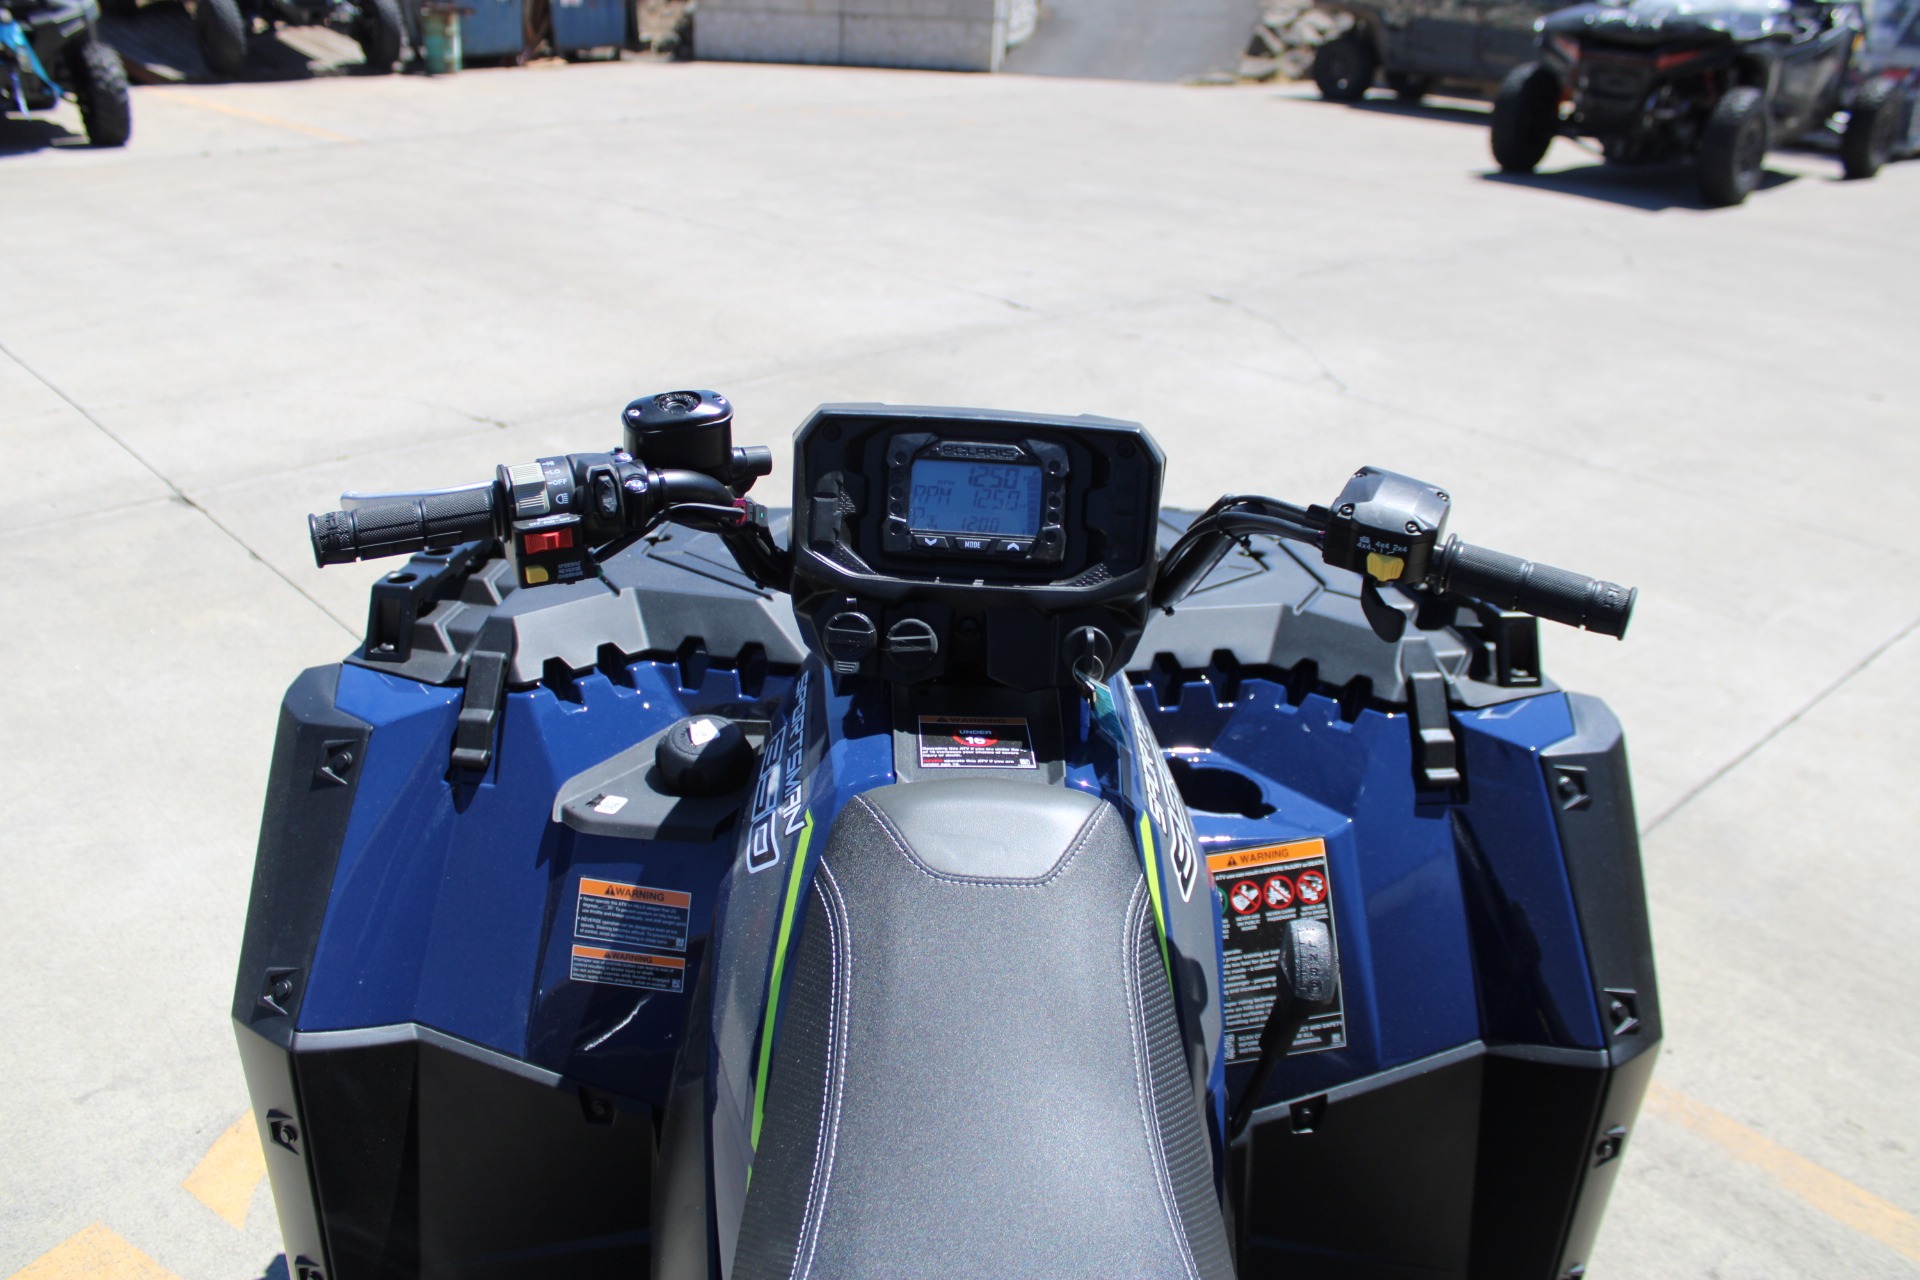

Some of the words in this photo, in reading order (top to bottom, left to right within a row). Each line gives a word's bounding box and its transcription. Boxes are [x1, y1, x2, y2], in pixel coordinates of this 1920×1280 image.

[942, 446, 1016, 458] POLARIS
[552, 478, 568, 486] OFF
[964, 540, 981, 549] MODE
[784, 670, 809, 836] SPORTSMAN
[1240, 848, 1289, 863] WARNING
[616, 887, 664, 902] WARNING
